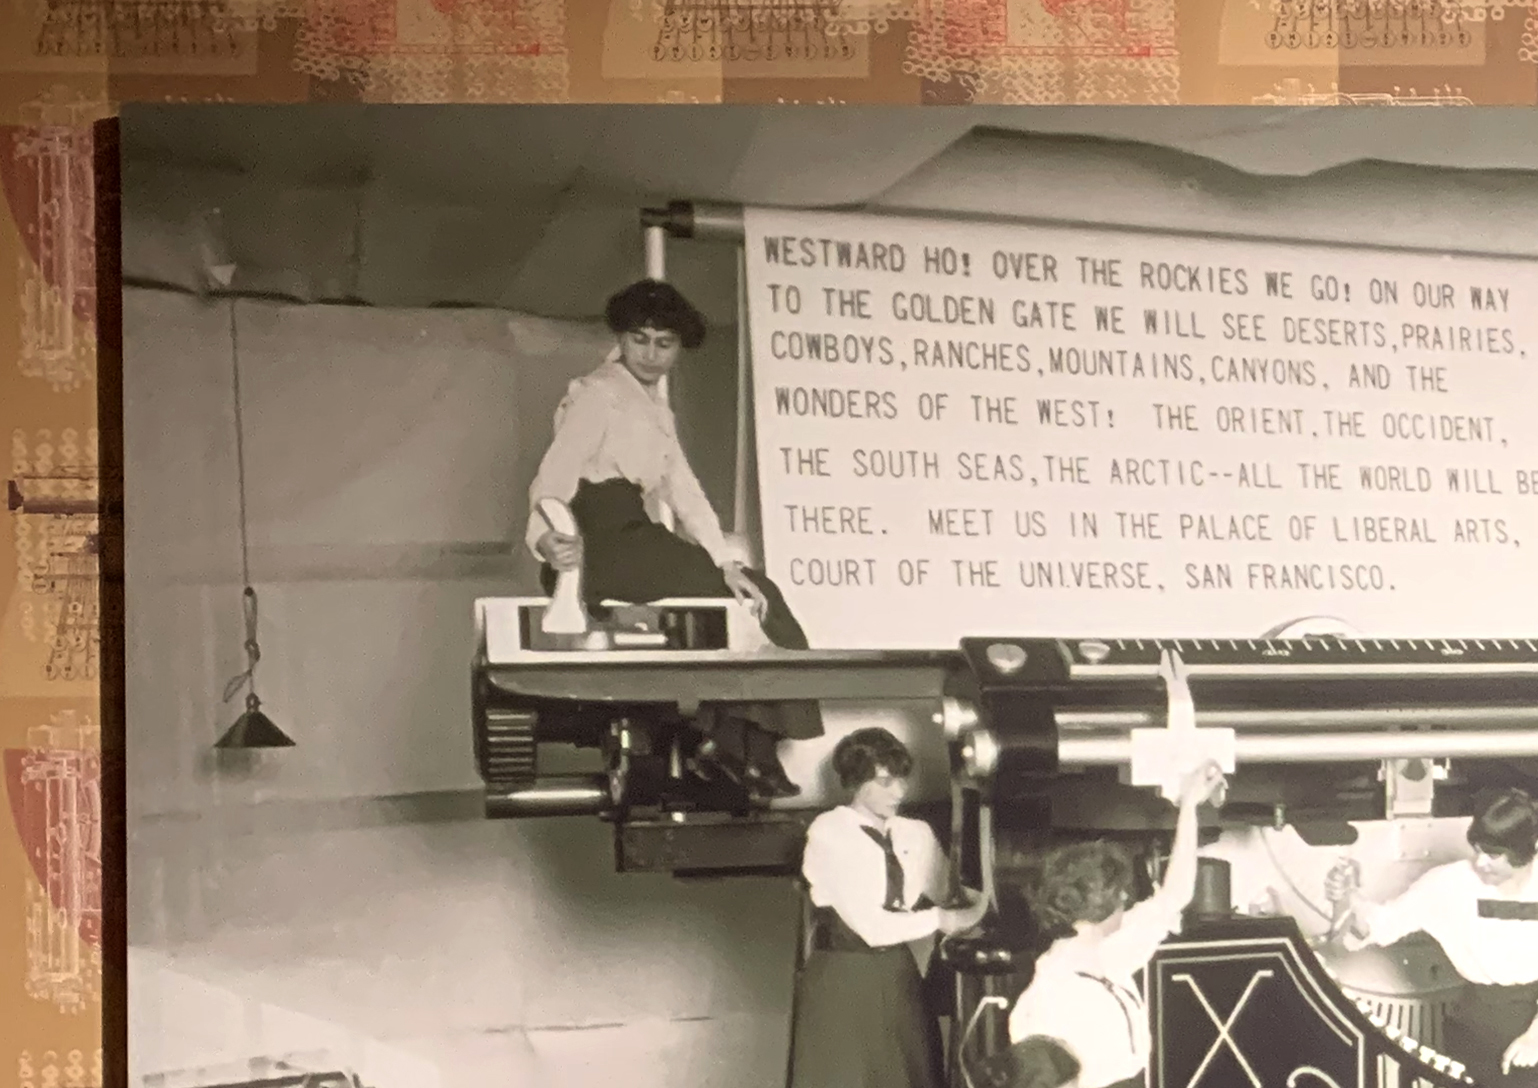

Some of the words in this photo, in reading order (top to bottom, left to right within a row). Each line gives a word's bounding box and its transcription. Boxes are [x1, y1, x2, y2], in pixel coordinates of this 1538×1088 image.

[763, 235, 907, 274] WESTWARD
[923, 245, 972, 278] HO!
[992, 250, 1058, 283] OVER
[1075, 256, 1123, 288] THE
[1140, 261, 1249, 296] ROCKIES
[1264, 271, 1293, 300] WE
[1310, 274, 1351, 303] GO!
[1369, 278, 1398, 305] ON
[1413, 281, 1455, 309] OUR
[1469, 286, 1509, 313] WAY
[766, 283, 802, 315] TO
[821, 287, 874, 320] THE
[891, 291, 996, 326] GOLDEN
[1012, 299, 1077, 332] GATE
[1094, 305, 1125, 335] WE
[1143, 308, 1206, 340] WILL
[1222, 312, 1267, 342] SEE
[1349, 363, 1391, 390] AND
[1405, 365, 1448, 393] THE
[774, 386, 898, 420] WONDERS
[918, 392, 949, 421] OF
[970, 394, 1019, 426] THE
[1152, 403, 1199, 432] THE
[779, 447, 831, 477] THE
[852, 449, 940, 479] SOUTH
[1297, 463, 1342, 490] THE
[1359, 465, 1432, 492] WORLD
[1446, 468, 1503, 494] WILL
[783, 504, 888, 535] THERE.
[928, 508, 993, 537] MEET
[1015, 510, 1047, 538] US
[1070, 512, 1098, 539] IN
[1114, 511, 1163, 540] THE
[1180, 513, 1273, 541] PALACE
[1289, 515, 1317, 542] OF
[1332, 516, 1437, 543] LIBERAL
[1454, 518, 1520, 548] ARTS,
[790, 557, 876, 587] COURT
[898, 559, 930, 587] OF
[951, 559, 1001, 588] THE
[1185, 563, 1233, 590] SAN
[1247, 563, 1395, 591] FRANCISCO.
